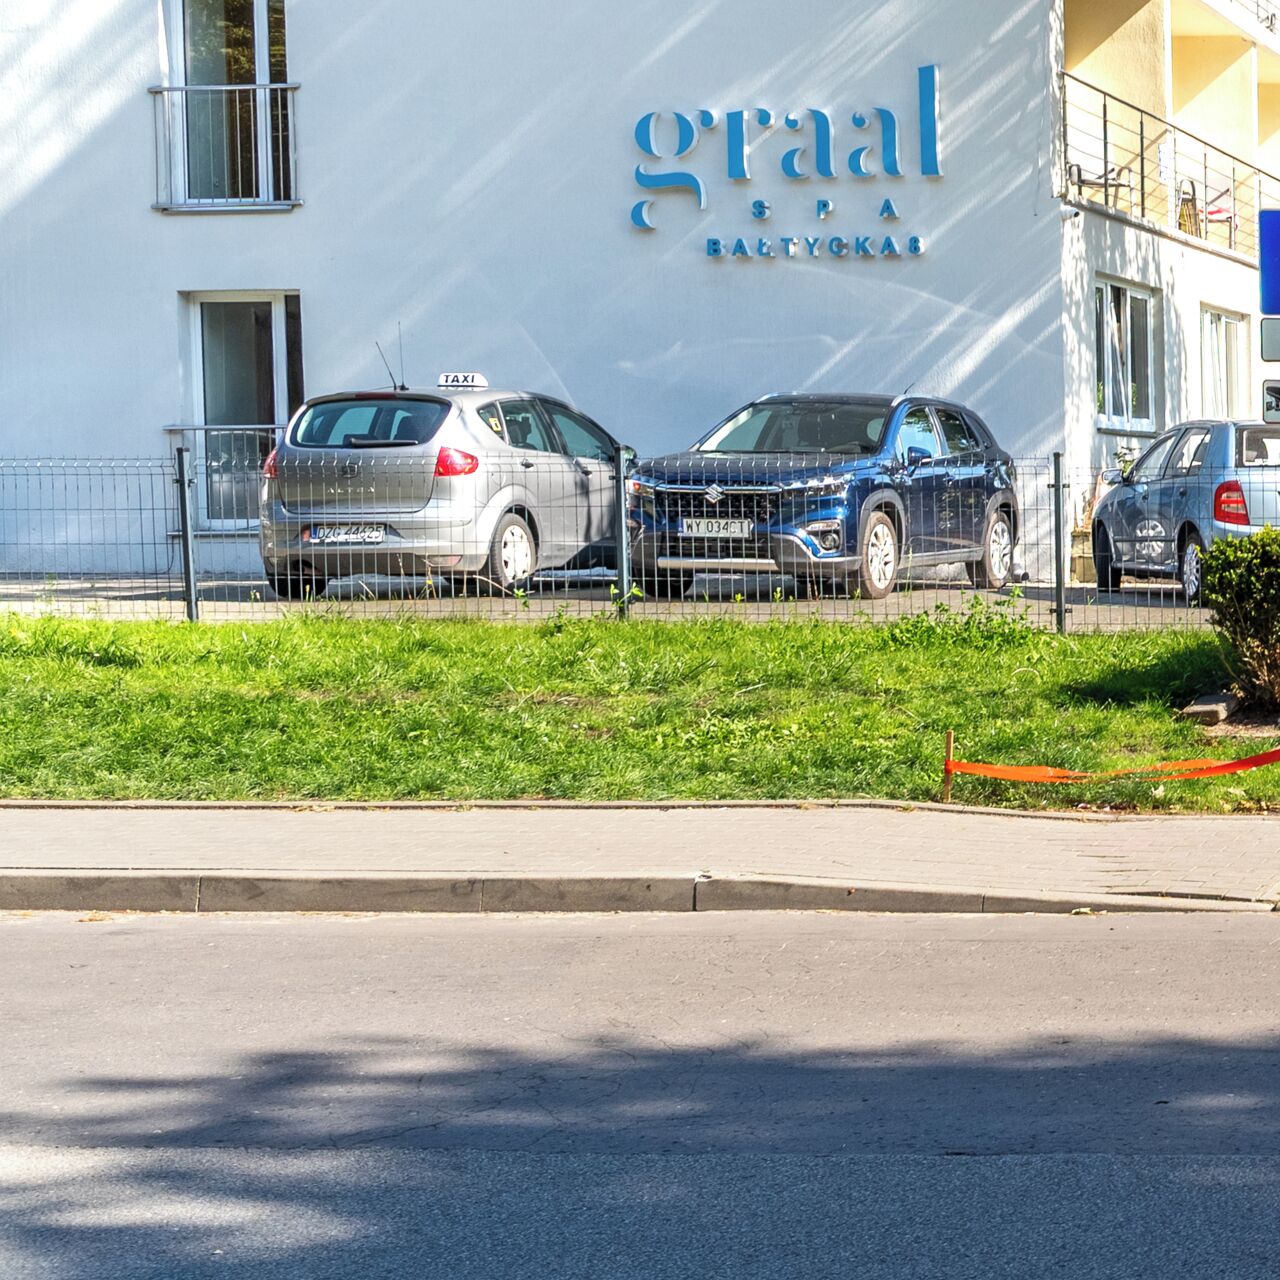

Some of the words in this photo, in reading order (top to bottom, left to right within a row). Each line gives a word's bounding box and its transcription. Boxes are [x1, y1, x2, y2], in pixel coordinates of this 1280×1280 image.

[631, 64, 942, 230] graal
[752, 199, 899, 220] SPA
[443, 374, 475, 383] TAXI
[685, 521, 700, 533] WY
[706, 520, 745, 533] 034CT
